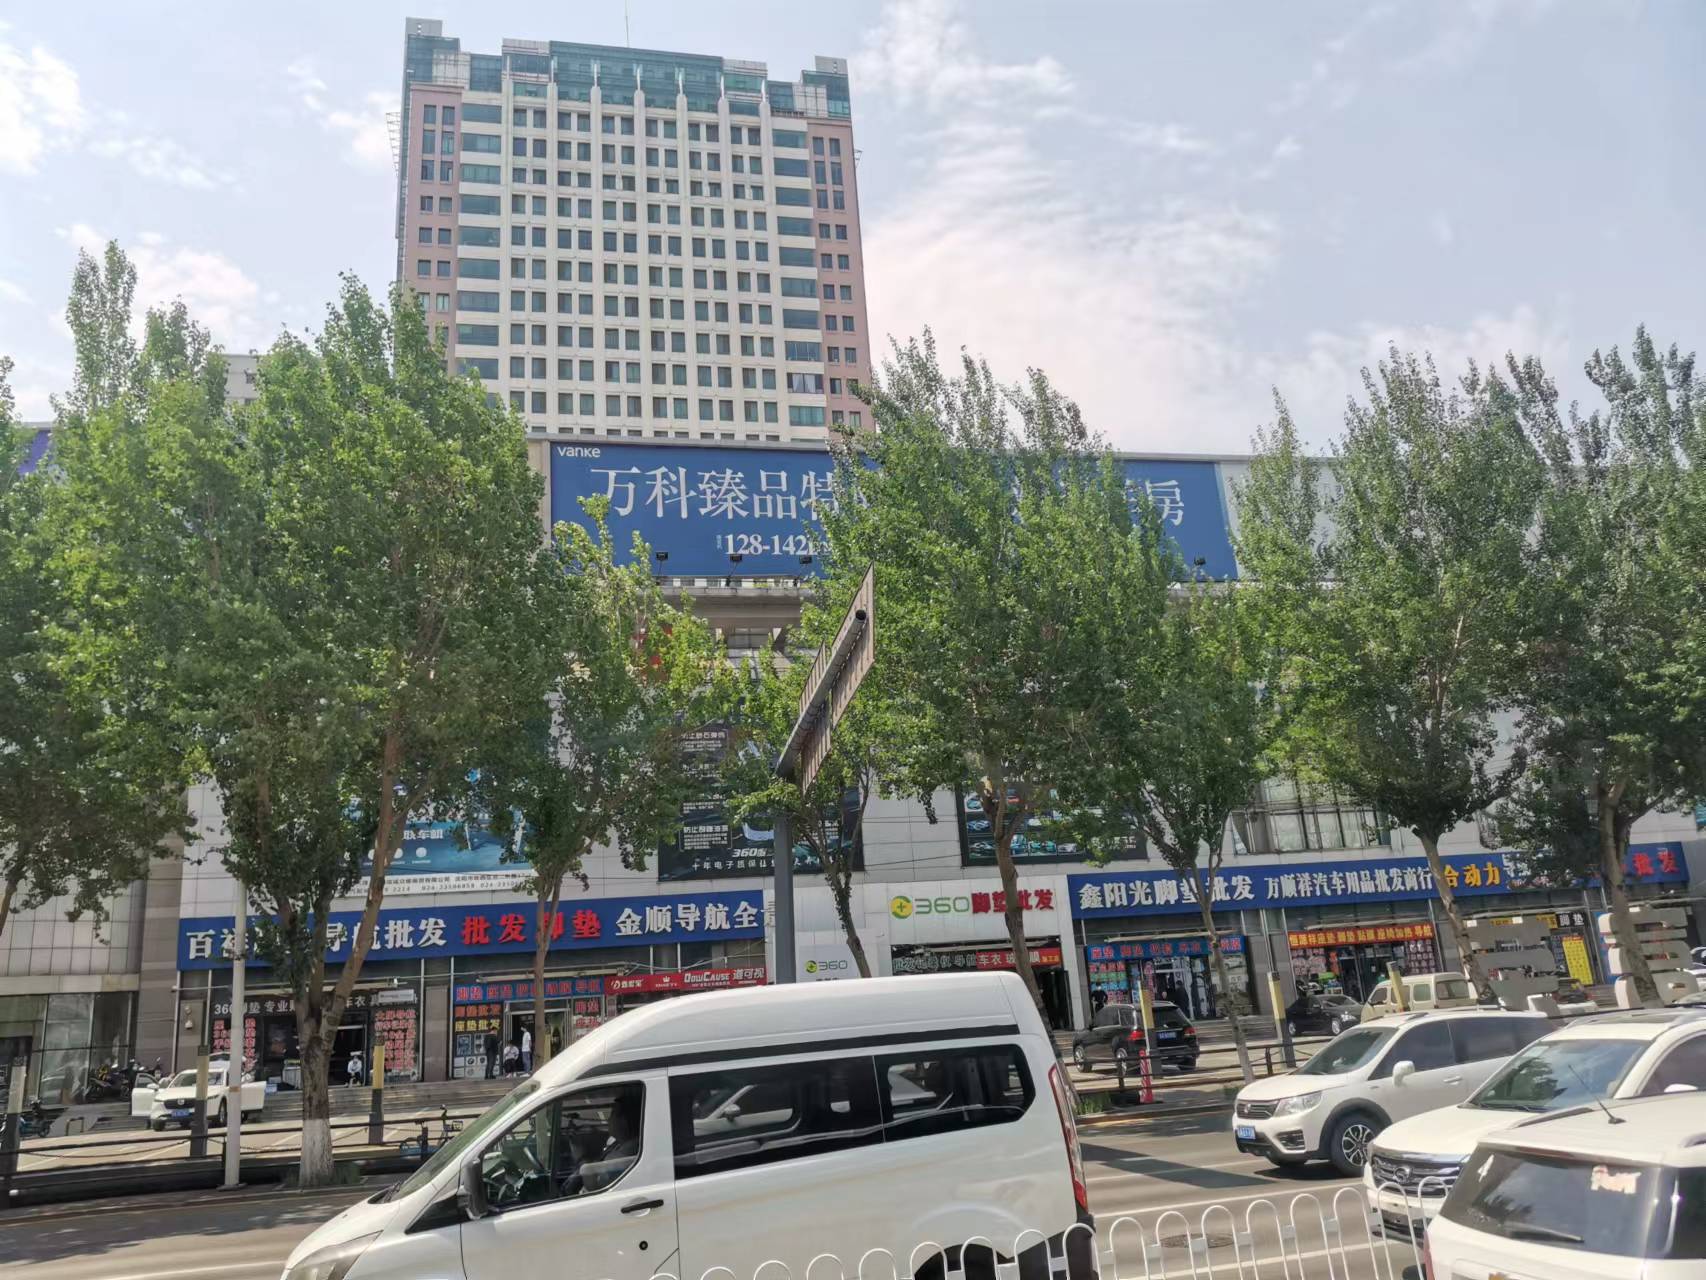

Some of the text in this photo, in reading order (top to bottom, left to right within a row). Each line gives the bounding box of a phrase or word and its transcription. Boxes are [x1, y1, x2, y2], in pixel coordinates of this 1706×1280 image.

[557, 446, 601, 458] vanke
[915, 897, 971, 914] 360
[819, 961, 847, 970] 360
